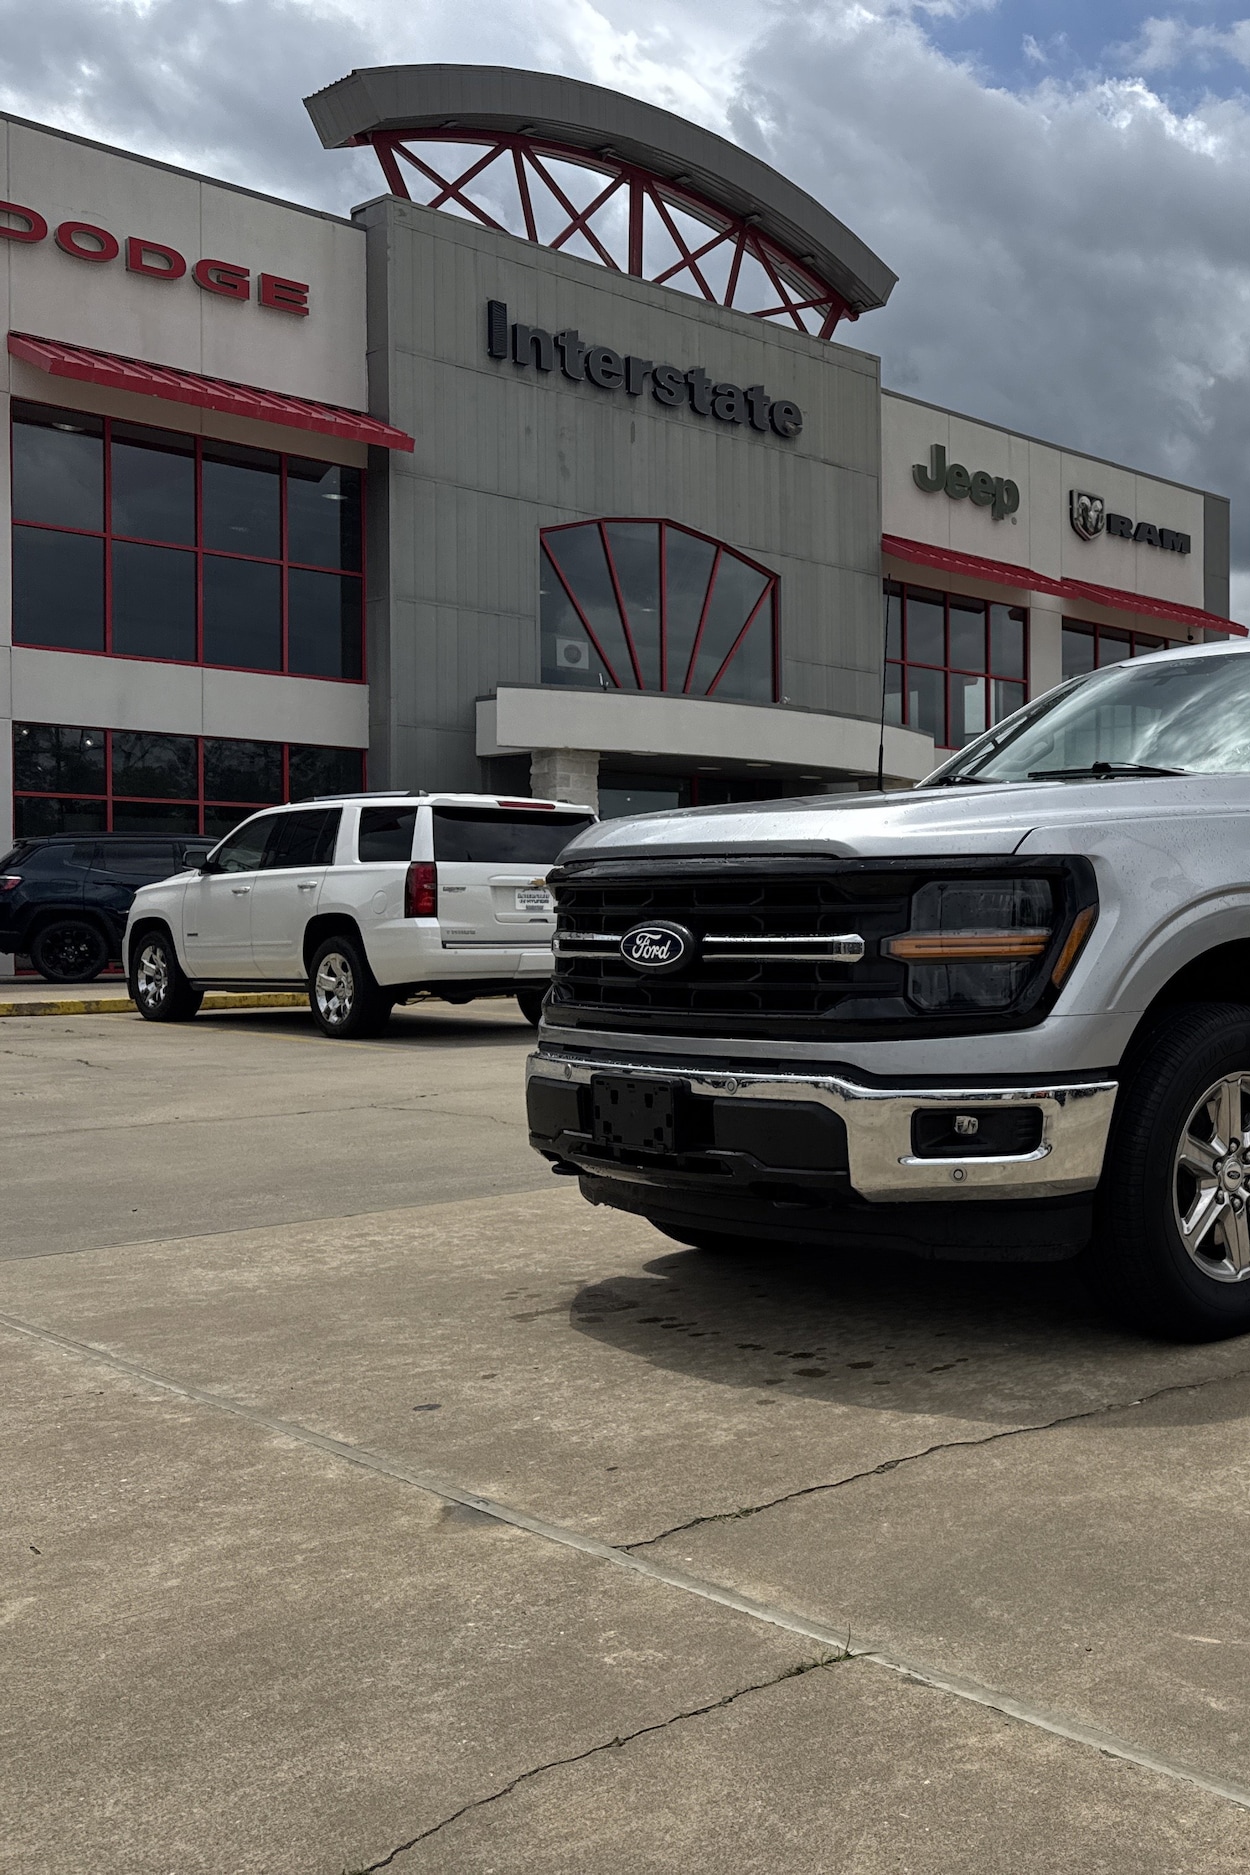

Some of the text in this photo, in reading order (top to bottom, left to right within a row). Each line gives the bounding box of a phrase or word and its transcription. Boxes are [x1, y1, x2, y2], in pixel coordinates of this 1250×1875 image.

[0, 201, 310, 316] DODGE
[487, 299, 803, 438] Interstate
[912, 444, 1020, 521] Jeep
[1106, 513, 1191, 554] RAM
[632, 932, 671, 959] Ford
